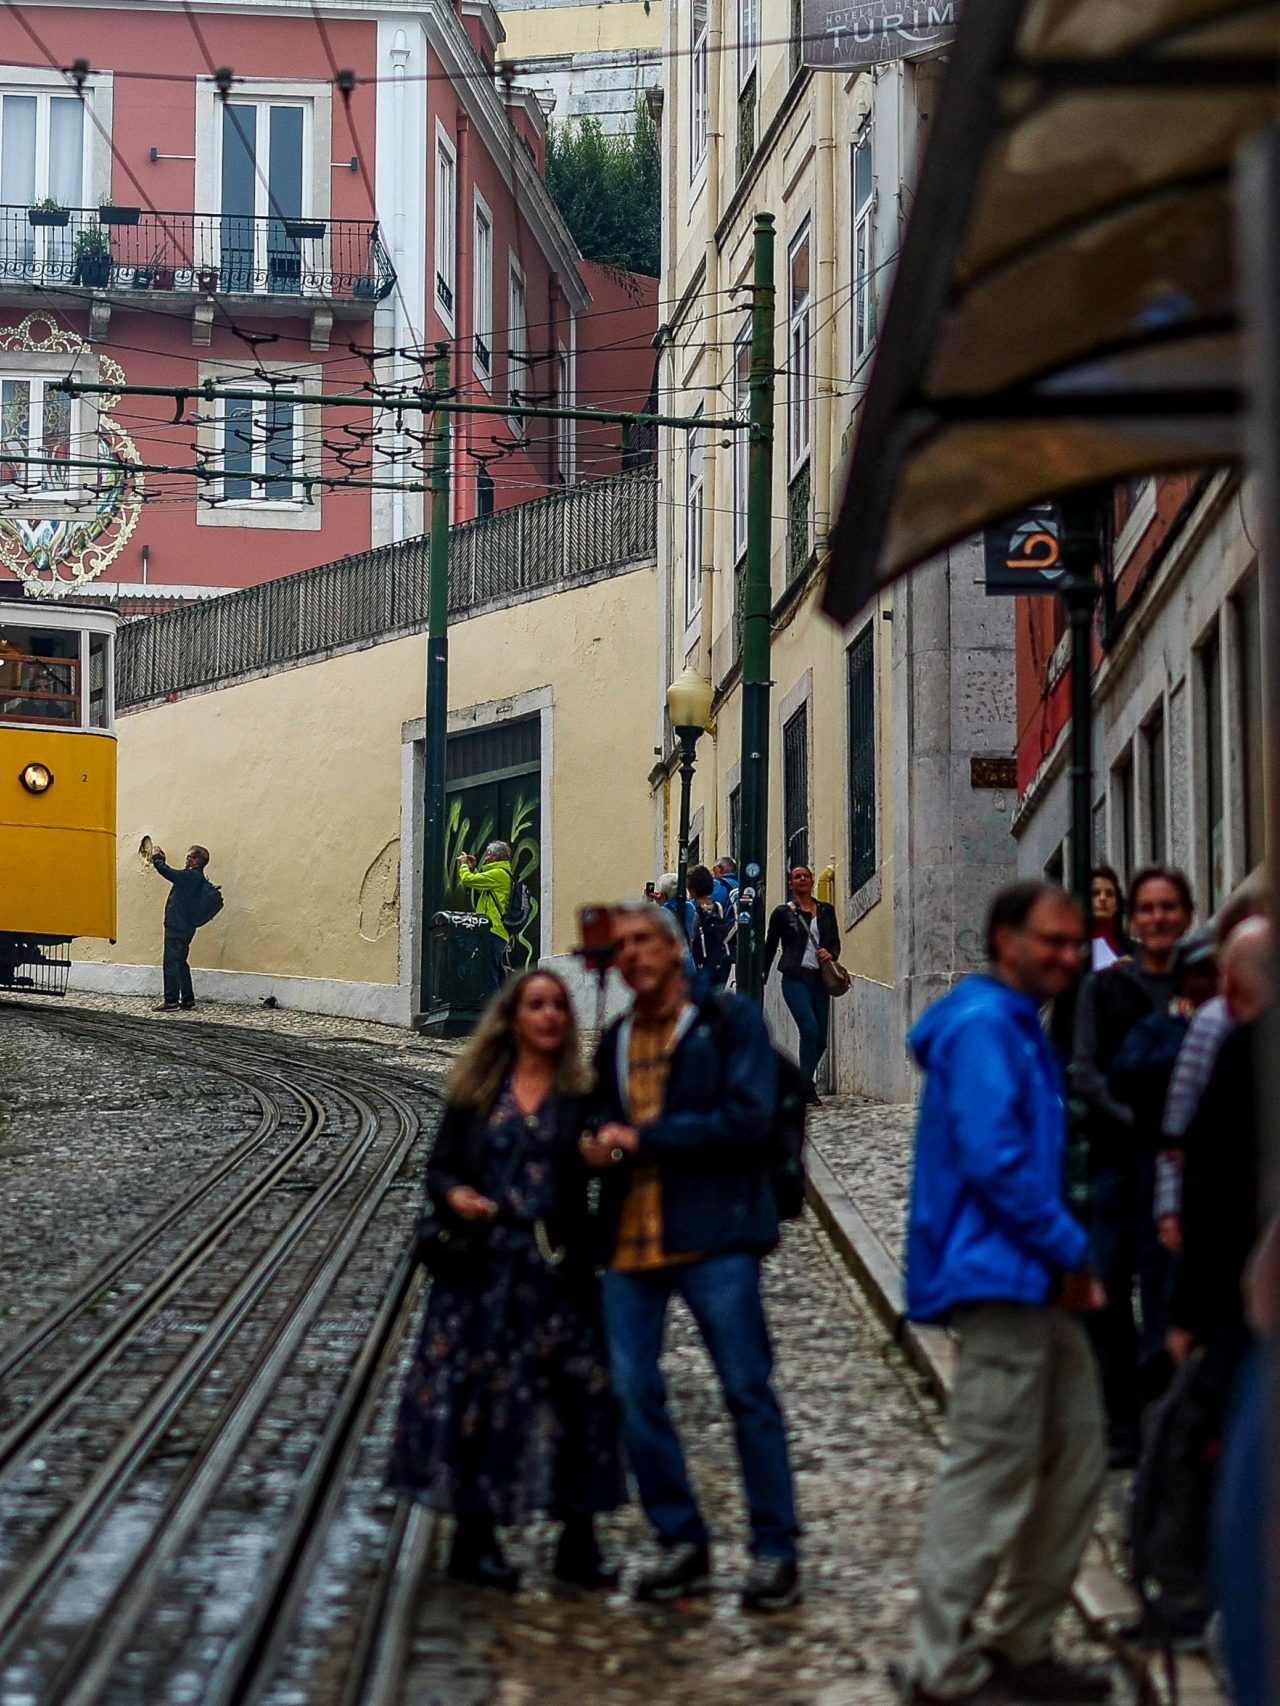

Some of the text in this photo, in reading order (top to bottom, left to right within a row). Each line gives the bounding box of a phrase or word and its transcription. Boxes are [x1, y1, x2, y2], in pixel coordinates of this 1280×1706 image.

[826, 7, 873, 25] HOTELS
[827, 3, 954, 48] TURIM
[82, 773, 88, 782] 2
